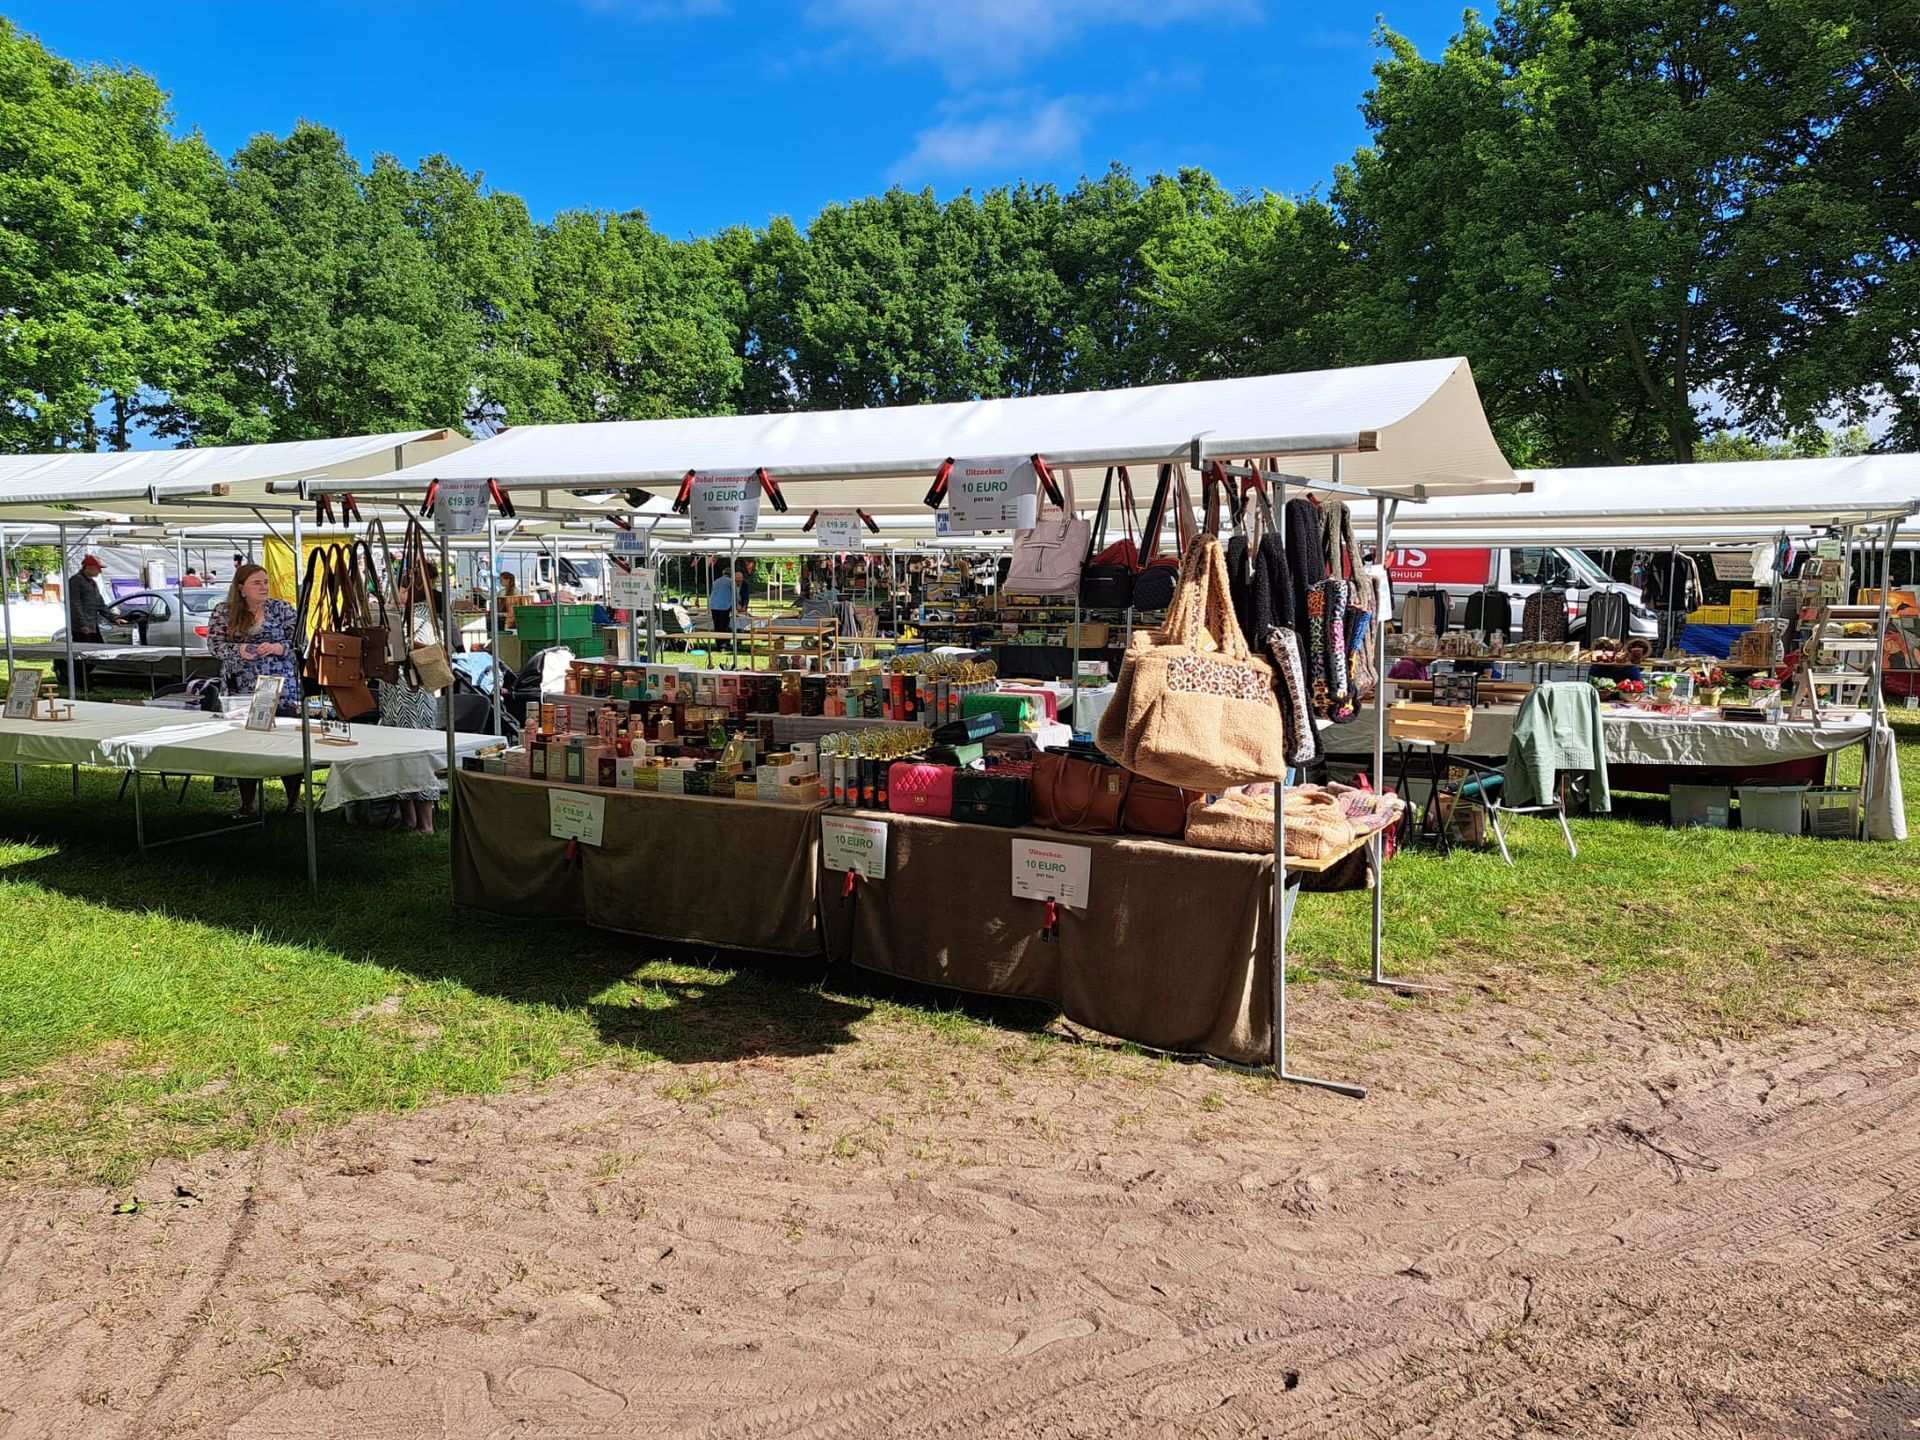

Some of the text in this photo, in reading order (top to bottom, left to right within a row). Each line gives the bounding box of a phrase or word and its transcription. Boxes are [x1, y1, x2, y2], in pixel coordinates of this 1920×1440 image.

[962, 481, 1008, 493] 10 EURO
[447, 496, 475, 507] €19.95
[702, 490, 747, 502] 10 EURO
[1391, 571, 1423, 579] RHUUR
[835, 834, 846, 844] 10
[847, 836, 874, 849] EURO
[1025, 860, 1066, 873] 10 EURO
